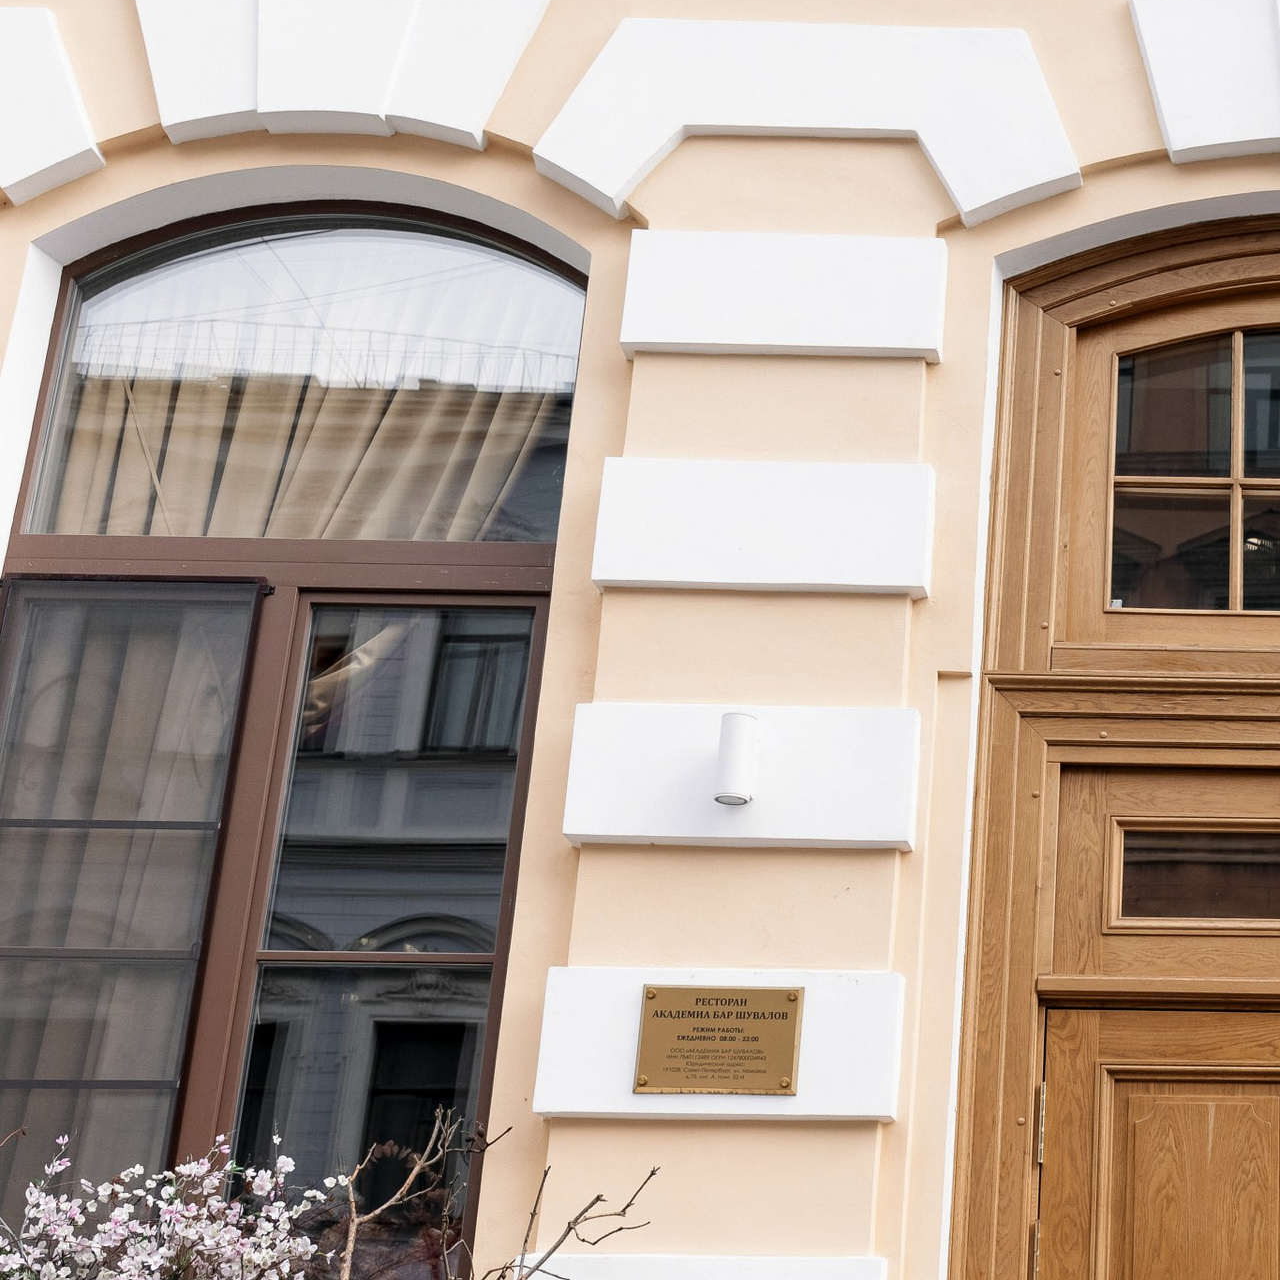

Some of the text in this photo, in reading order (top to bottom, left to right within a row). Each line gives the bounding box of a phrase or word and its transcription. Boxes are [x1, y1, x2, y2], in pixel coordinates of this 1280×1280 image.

[695, 997, 748, 1007] РЕСТОРАН
[652, 1009, 789, 1021] АКАДЕМИА БАР ШУВАЛОВ
